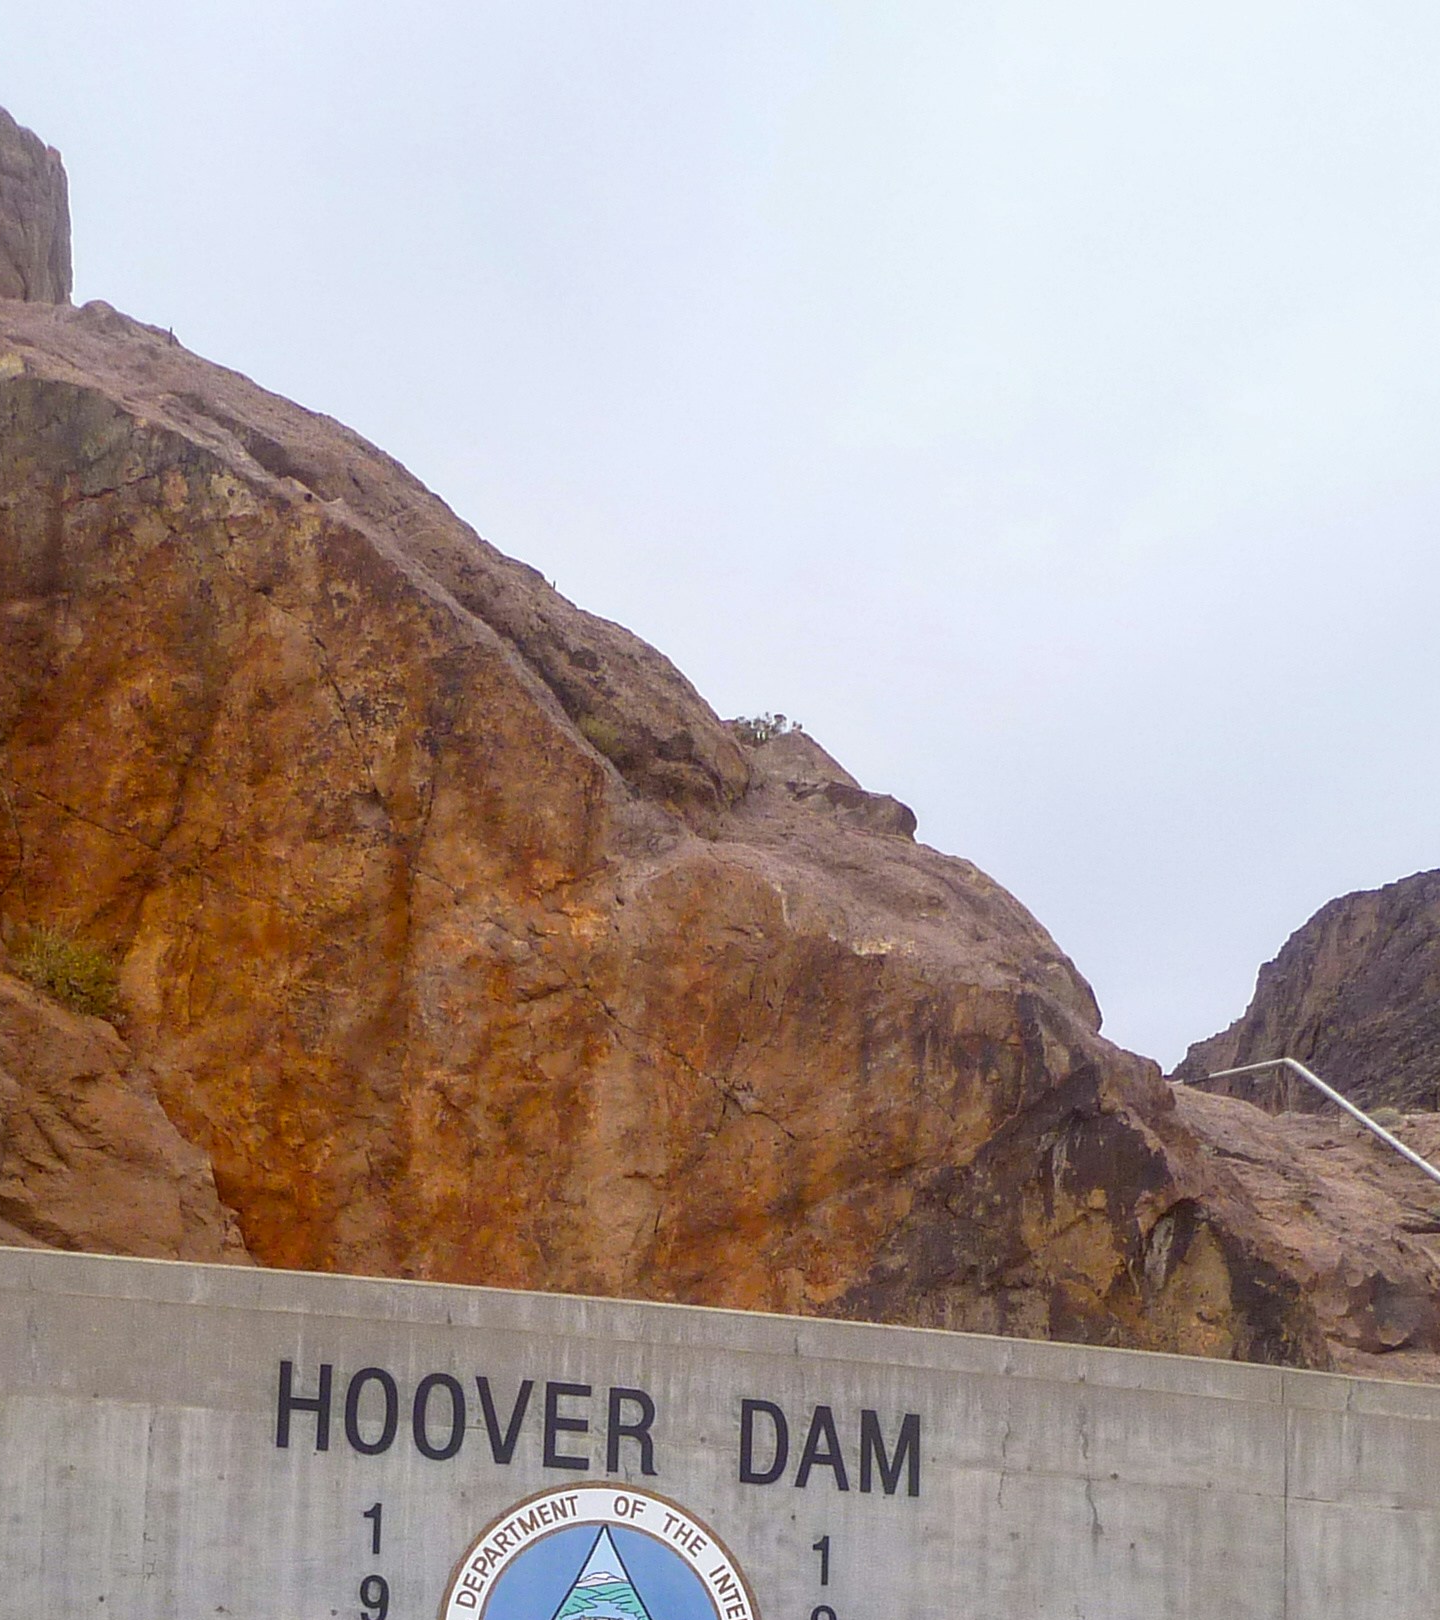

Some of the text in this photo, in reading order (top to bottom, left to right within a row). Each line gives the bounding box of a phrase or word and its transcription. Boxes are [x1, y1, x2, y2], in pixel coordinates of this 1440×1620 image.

[276, 1360, 922, 1498] HOOVER DAM
[456, 1495, 579, 1610] DEPARTMENT
[613, 1495, 647, 1520] OF
[665, 1512, 708, 1558] THE
